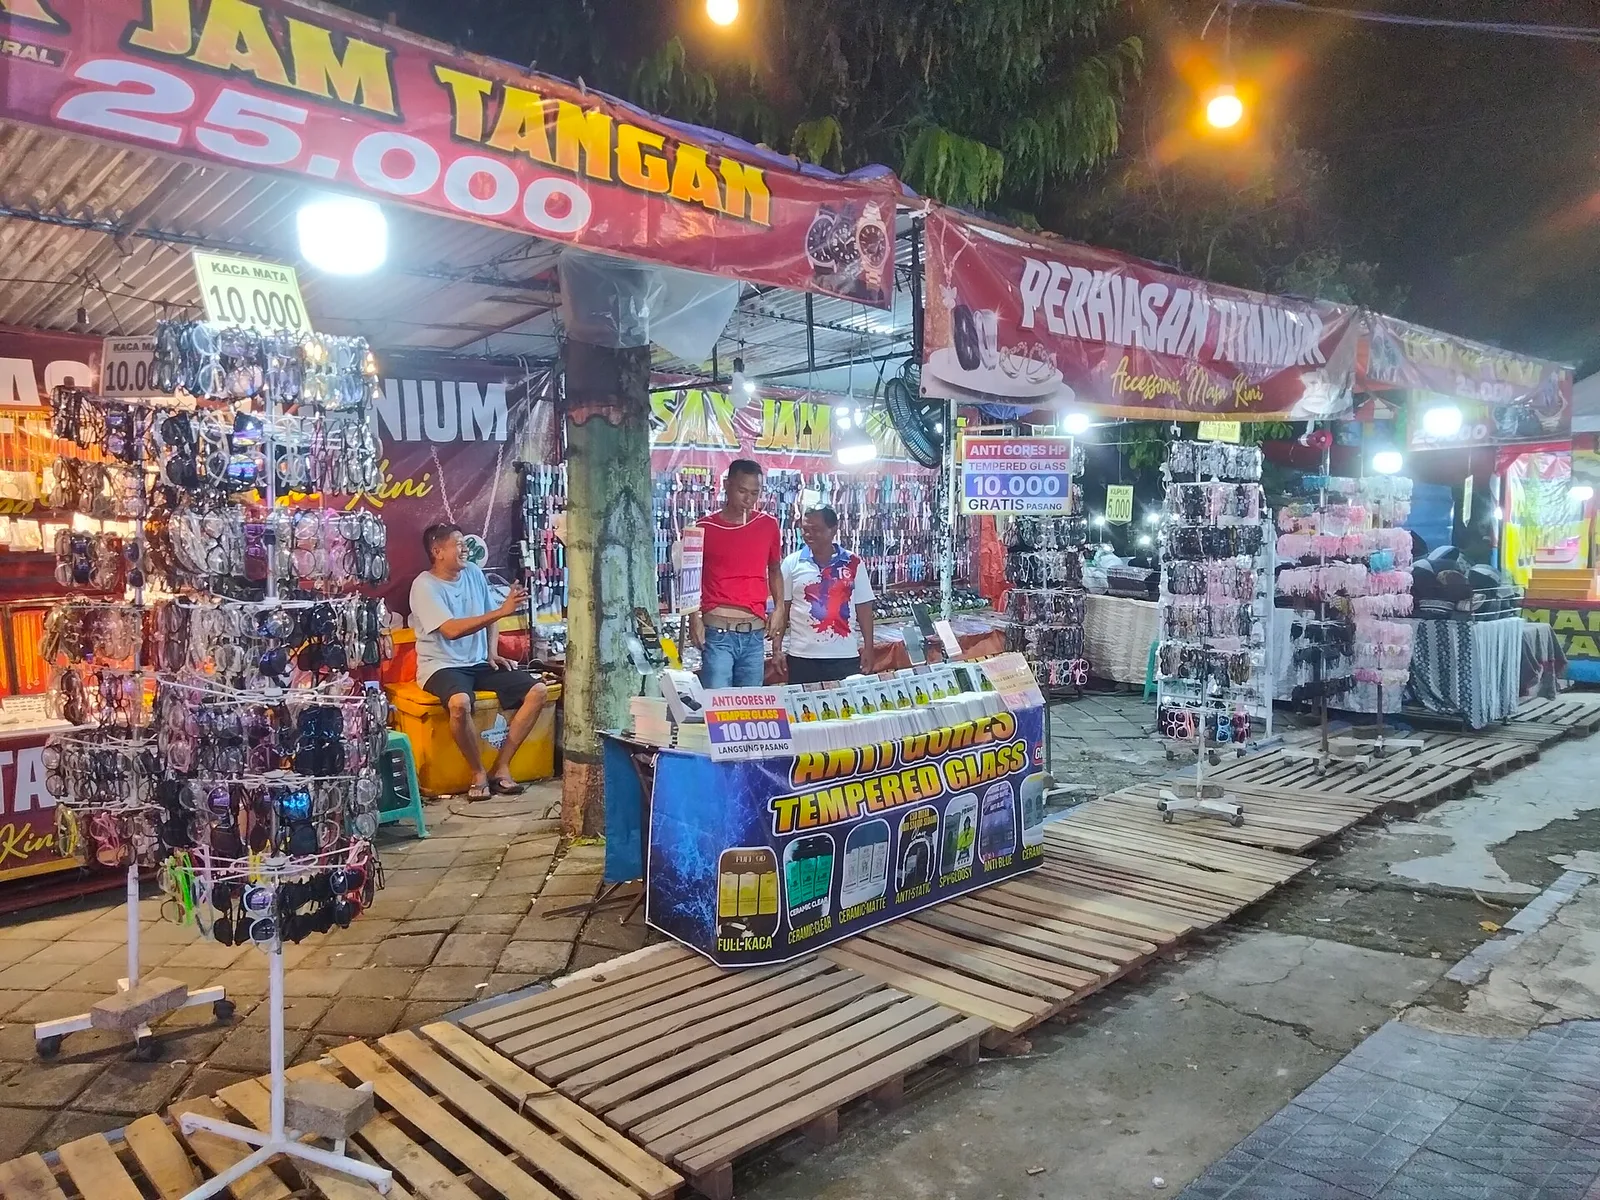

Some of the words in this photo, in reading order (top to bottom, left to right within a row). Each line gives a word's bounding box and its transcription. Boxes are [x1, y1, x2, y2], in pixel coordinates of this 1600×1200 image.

[0, 40, 55, 65] RAL
[128, 0, 395, 118] JAM
[434, 64, 773, 226] TANGAN
[56, 59, 592, 233] 25.000
[211, 261, 250, 276] KACA
[253, 269, 289, 282] MATA
[210, 285, 301, 328] 10.000
[1020, 255, 1210, 362] PERHIASAN
[113, 342, 139, 351] KACA
[969, 444, 1001, 456] ANTI
[1003, 444, 1047, 456] GORES
[1049, 444, 1067, 456] HP
[968, 461, 1027, 471] TEMPERED
[1029, 461, 1067, 471] GLASS
[973, 475, 1060, 496] 10.000
[968, 498, 1025, 511] GRATIS
[1026, 503, 1062, 511] PASANG
[1107, 498, 1131, 519] 5.000
[711, 695, 734, 707] ANTI
[735, 695, 764, 706] GORES
[765, 694, 776, 705] HP
[715, 710, 752, 722] TEMPER
[751, 709, 779, 720] GLASS
[719, 721, 780, 742] 10.000
[718, 744, 759, 754] LANGSUNG
[760, 742, 789, 751] PASANG
[773, 766, 941, 831] TEMPERED
[944, 741, 1026, 790] GLASS
[789, 903, 812, 917] CERAMIC
